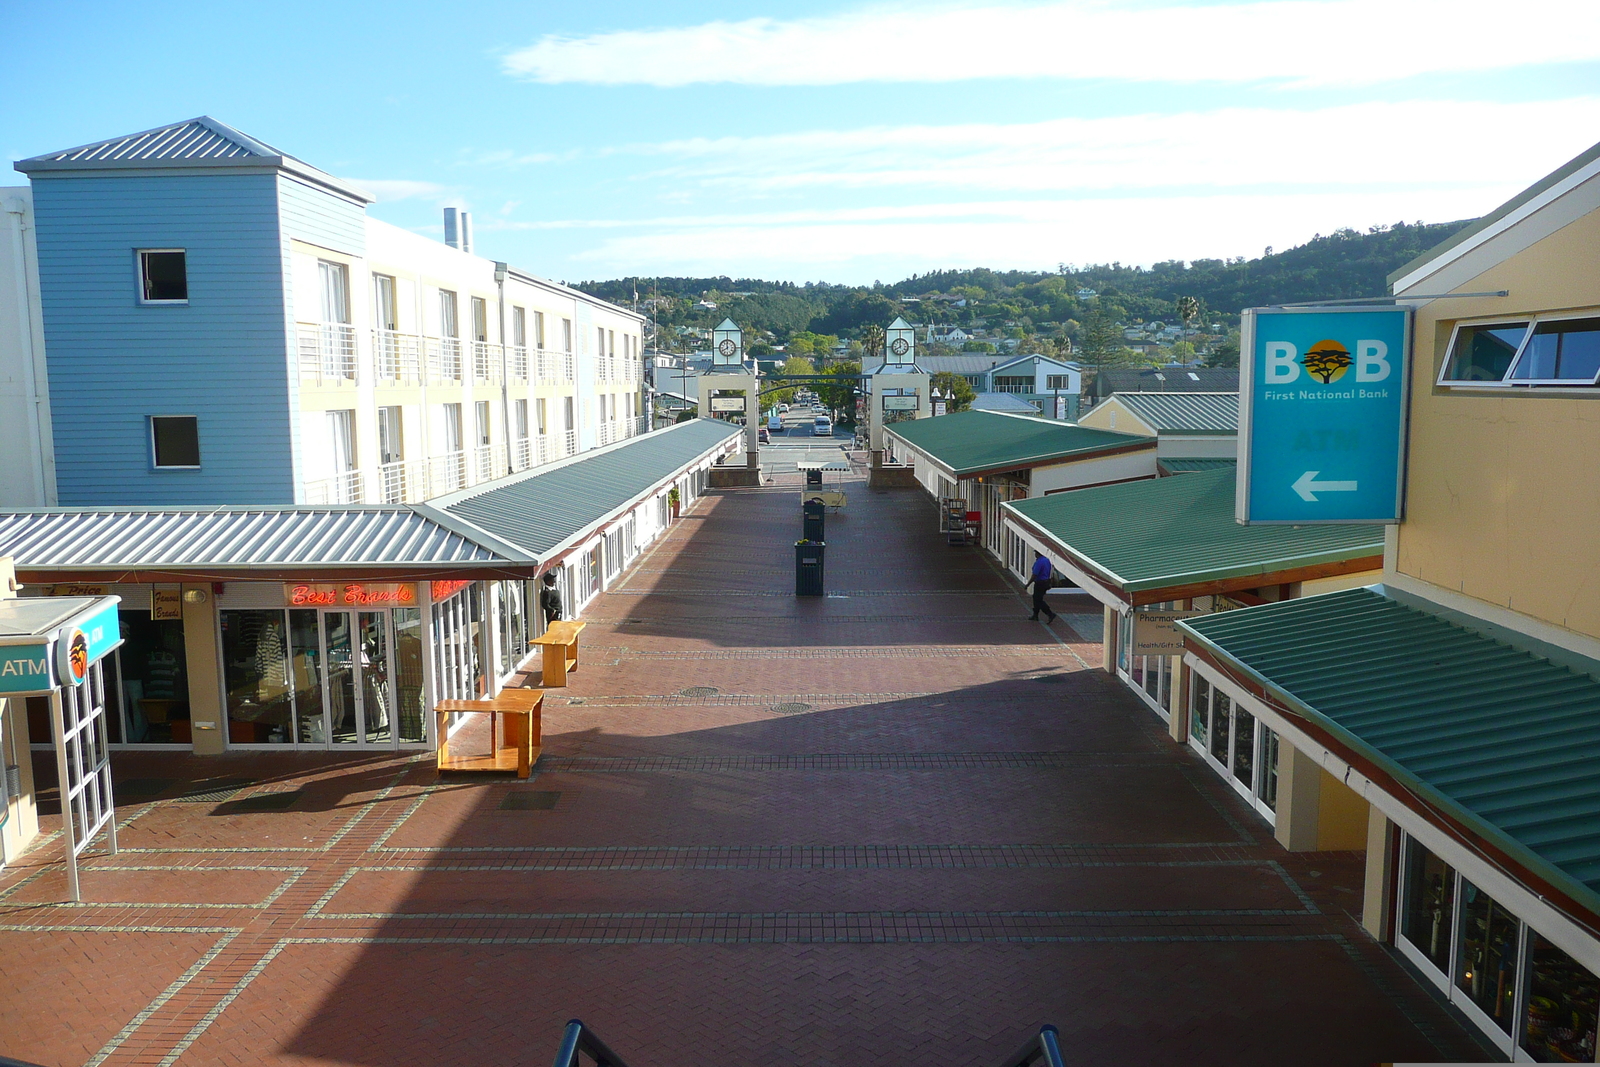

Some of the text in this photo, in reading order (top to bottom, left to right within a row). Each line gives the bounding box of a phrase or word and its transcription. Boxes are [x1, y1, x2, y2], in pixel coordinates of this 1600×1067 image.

[1265, 388, 1389, 401] First National Bank
[67, 584, 102, 595] Price
[291, 586, 337, 605] Best
[344, 586, 412, 604] Brands
[155, 592, 179, 603] Famous
[155, 606, 179, 618] Brands
[91, 625, 104, 645] ATM
[1138, 641, 1174, 650] Health/Gift
[1, 658, 47, 677] ATM
